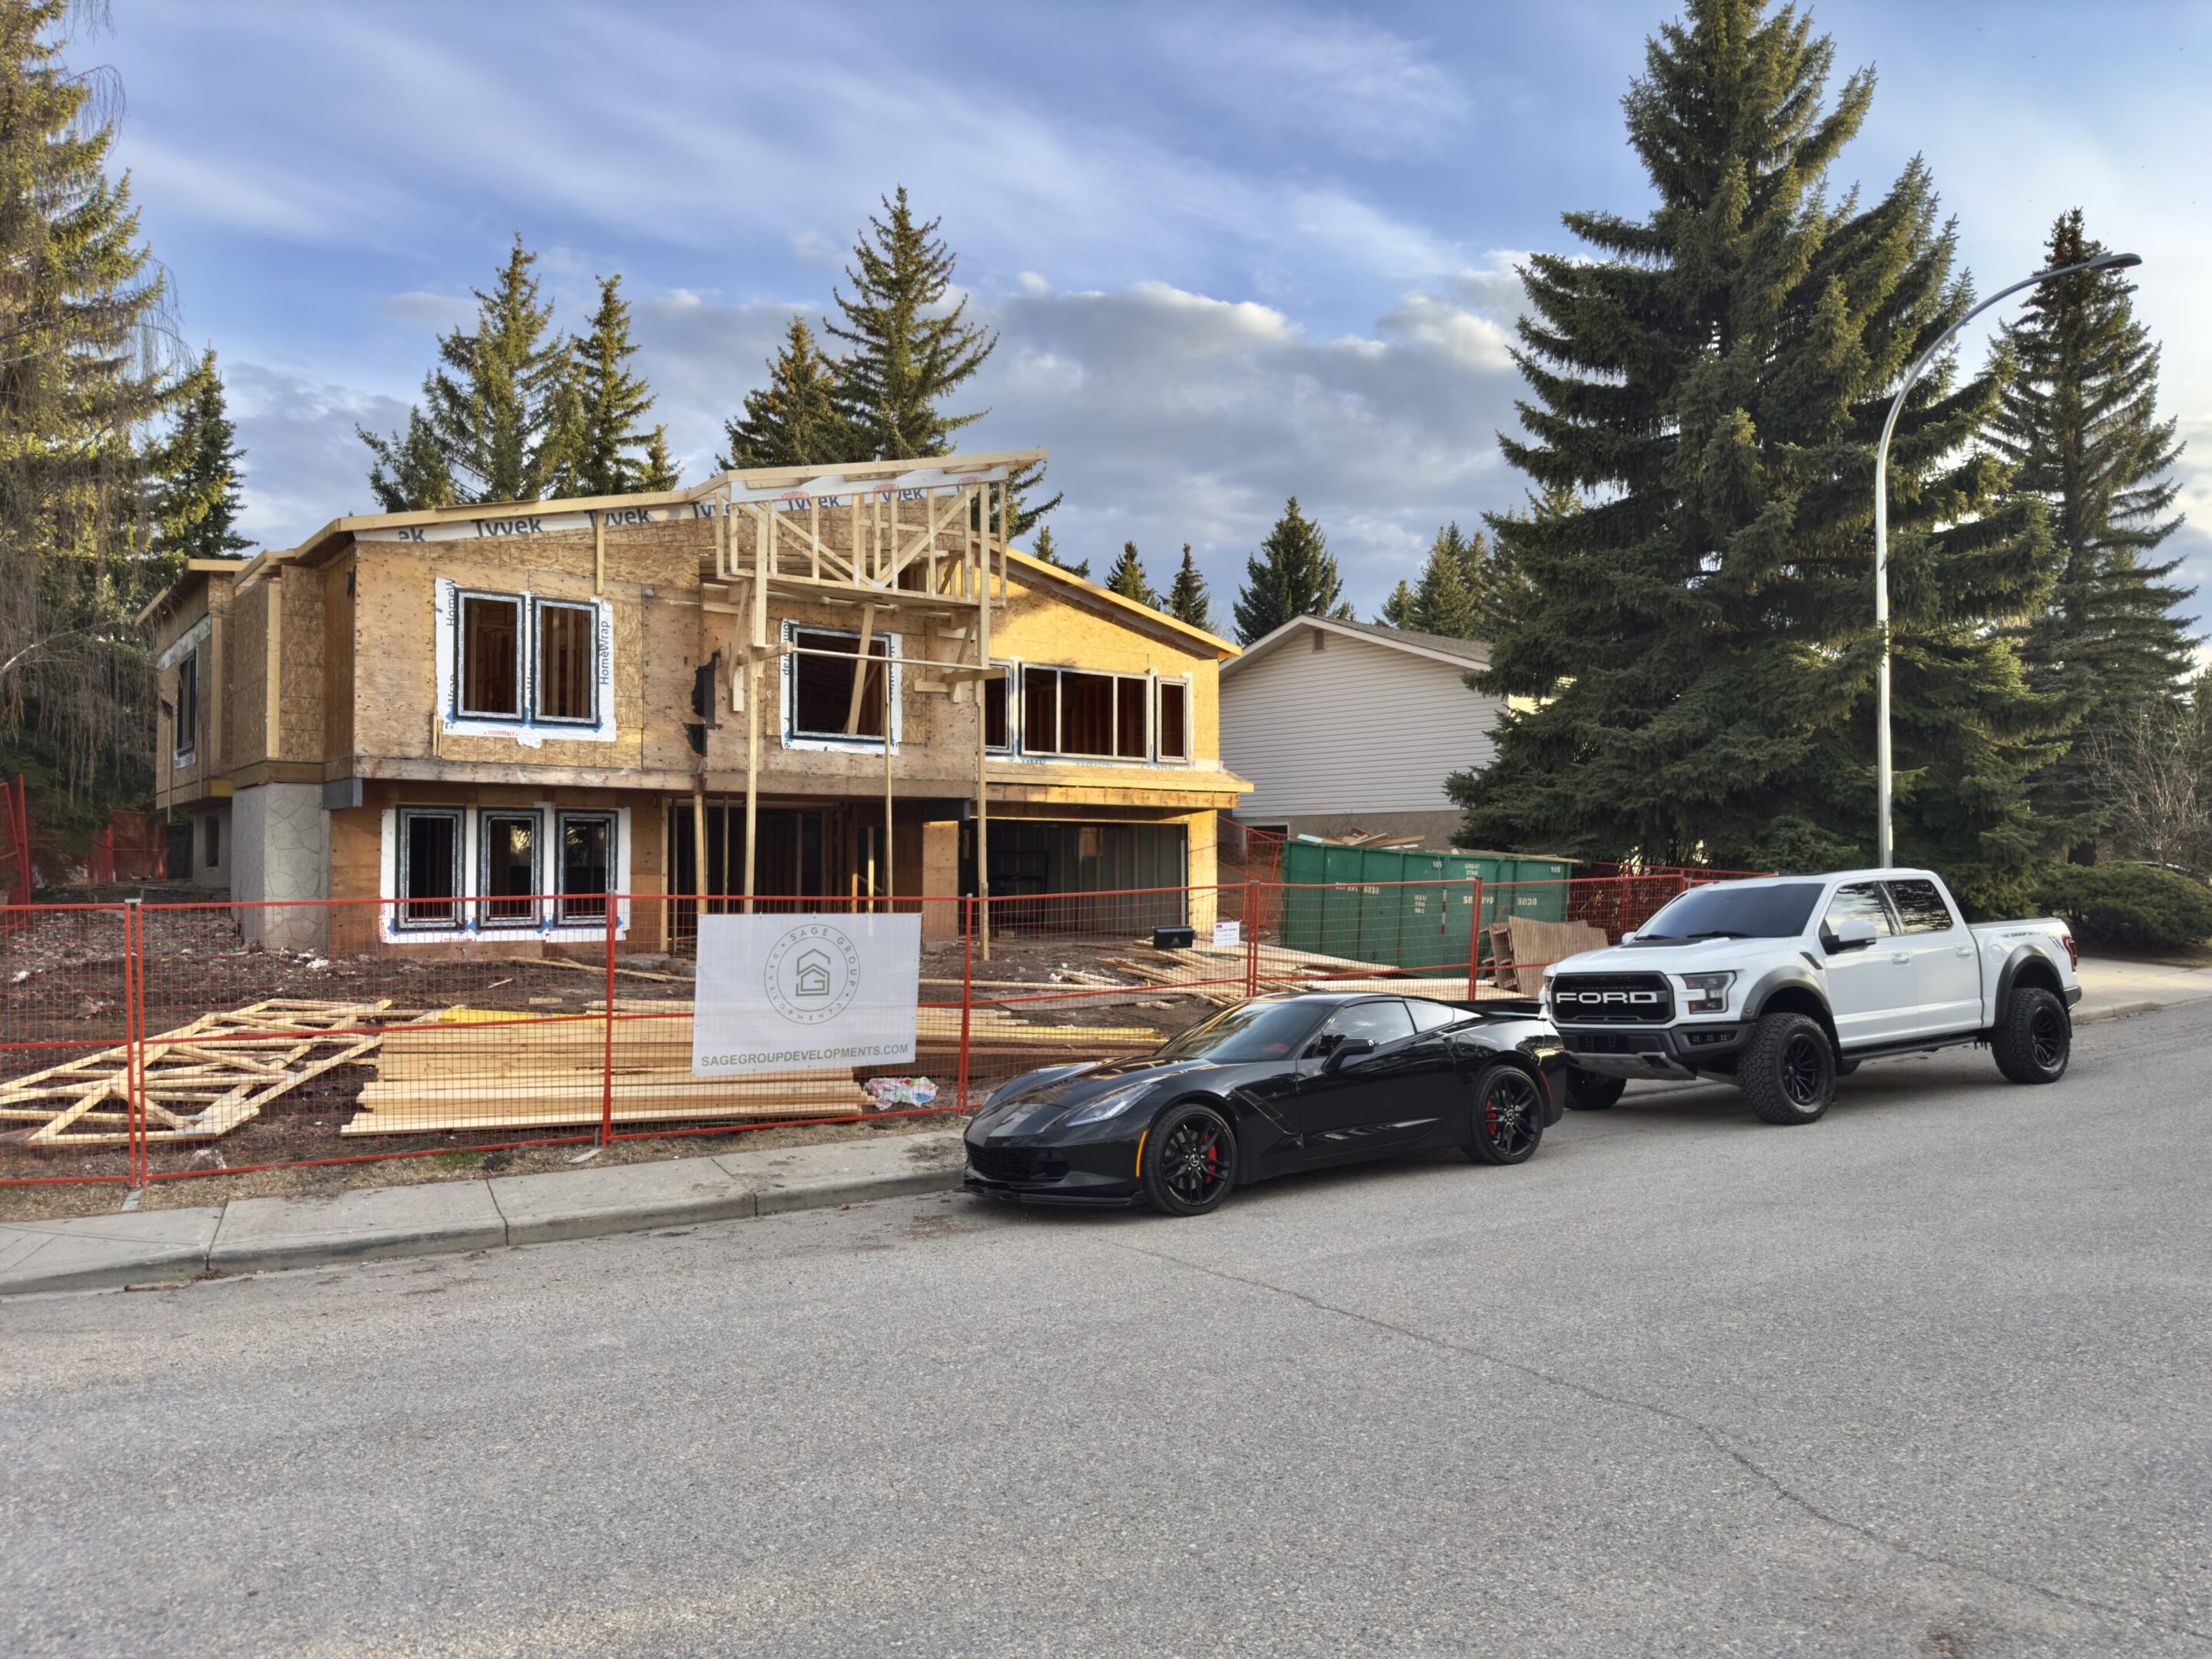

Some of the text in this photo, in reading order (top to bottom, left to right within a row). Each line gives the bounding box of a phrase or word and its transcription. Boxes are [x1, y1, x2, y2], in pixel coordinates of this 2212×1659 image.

[599, 621, 611, 685] HomeWrap
[768, 953, 843, 1021] DEVELOPMENTS
[790, 926, 858, 987] SAGE GROUP
[1556, 991, 1657, 1004] FORD
[701, 1043, 909, 1068] SAGEGROUPDEVELOPMENTS.COM
